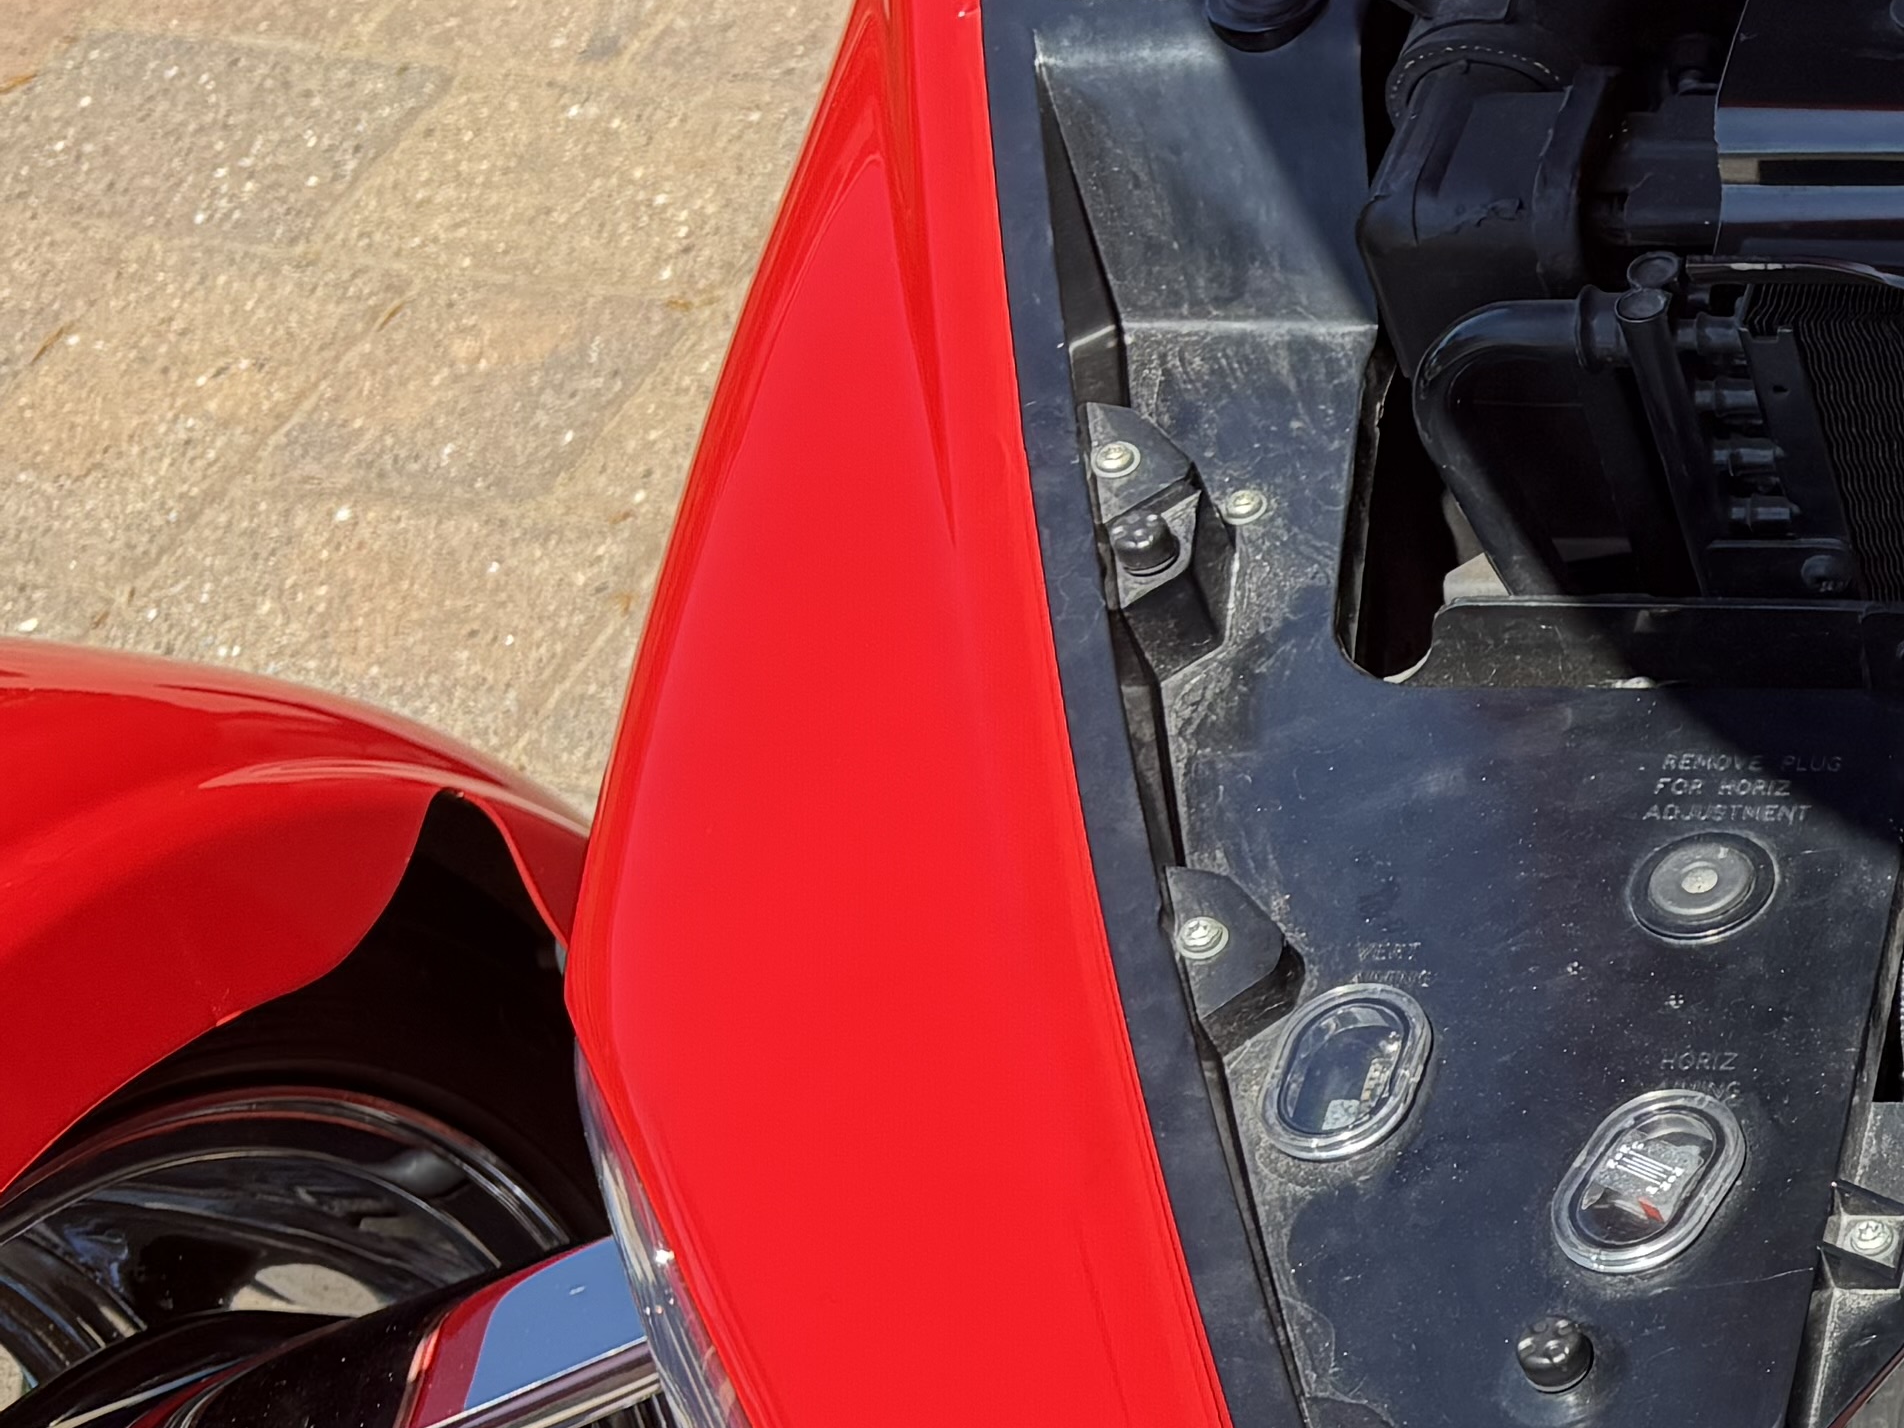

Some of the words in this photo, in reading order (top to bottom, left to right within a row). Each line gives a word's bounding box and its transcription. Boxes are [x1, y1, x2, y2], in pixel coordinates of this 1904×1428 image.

[1662, 754, 1763, 770] REMOVE
[1782, 756, 1841, 771] PLUG
[1654, 778, 1702, 794] FOR
[1718, 778, 1791, 796] HORIZ
[1643, 804, 1812, 823] ADJUSTMENT
[1660, 1052, 1738, 1070] HORIZ
